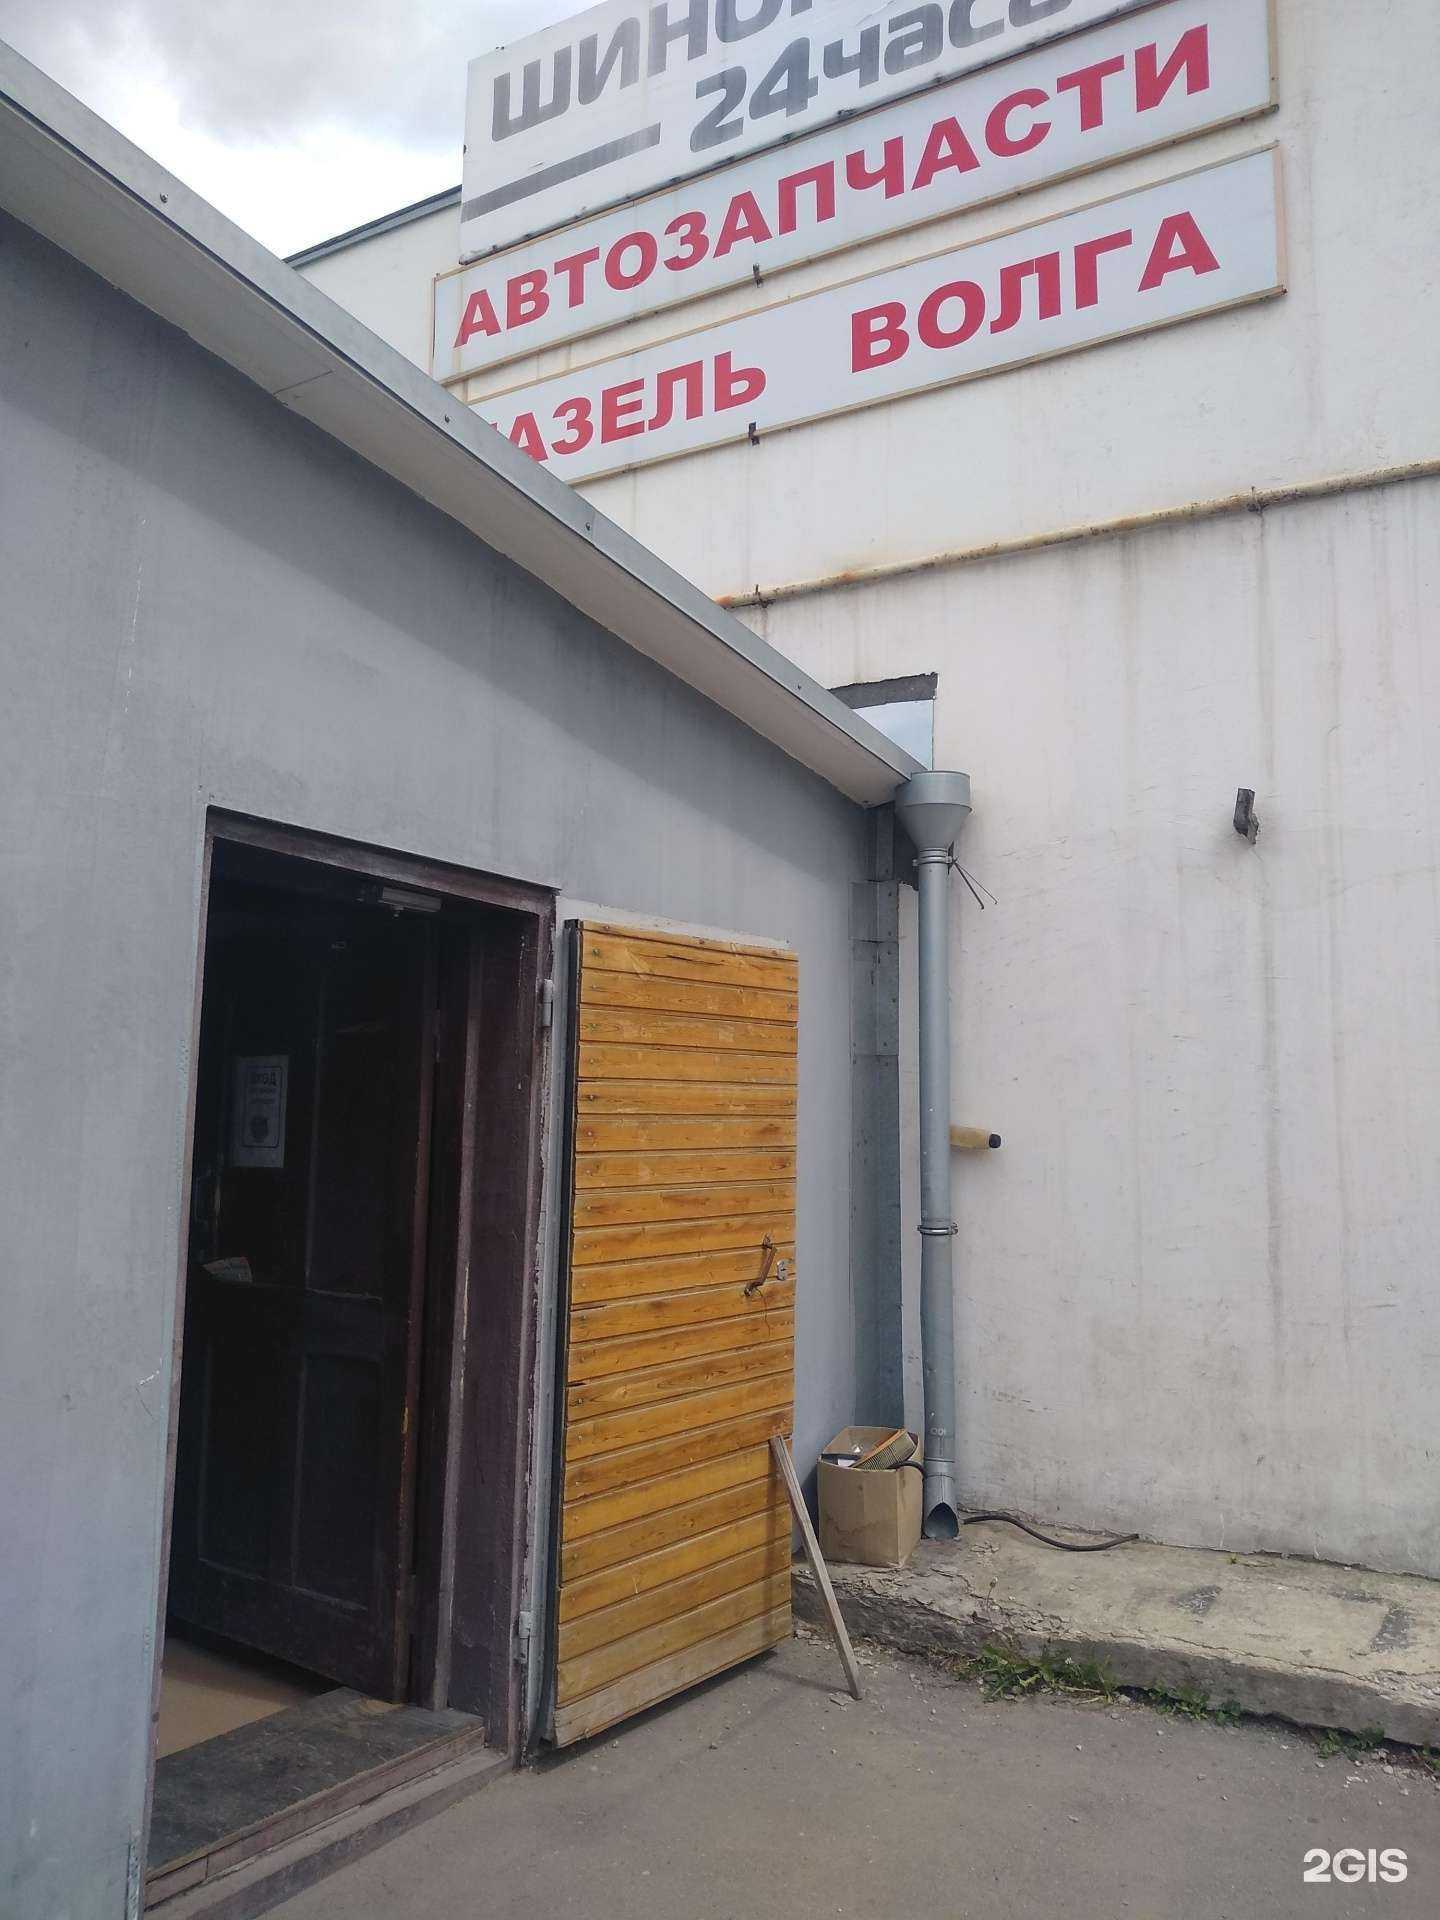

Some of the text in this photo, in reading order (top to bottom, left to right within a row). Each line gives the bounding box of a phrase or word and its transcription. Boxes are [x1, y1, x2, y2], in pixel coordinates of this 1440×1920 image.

[454, 24, 1209, 347] АВТОЗАПЧАСТИ
[491, 0, 813, 142] ШИНО
[488, 211, 1221, 462] АЗЕЛЬ ВОЛГА
